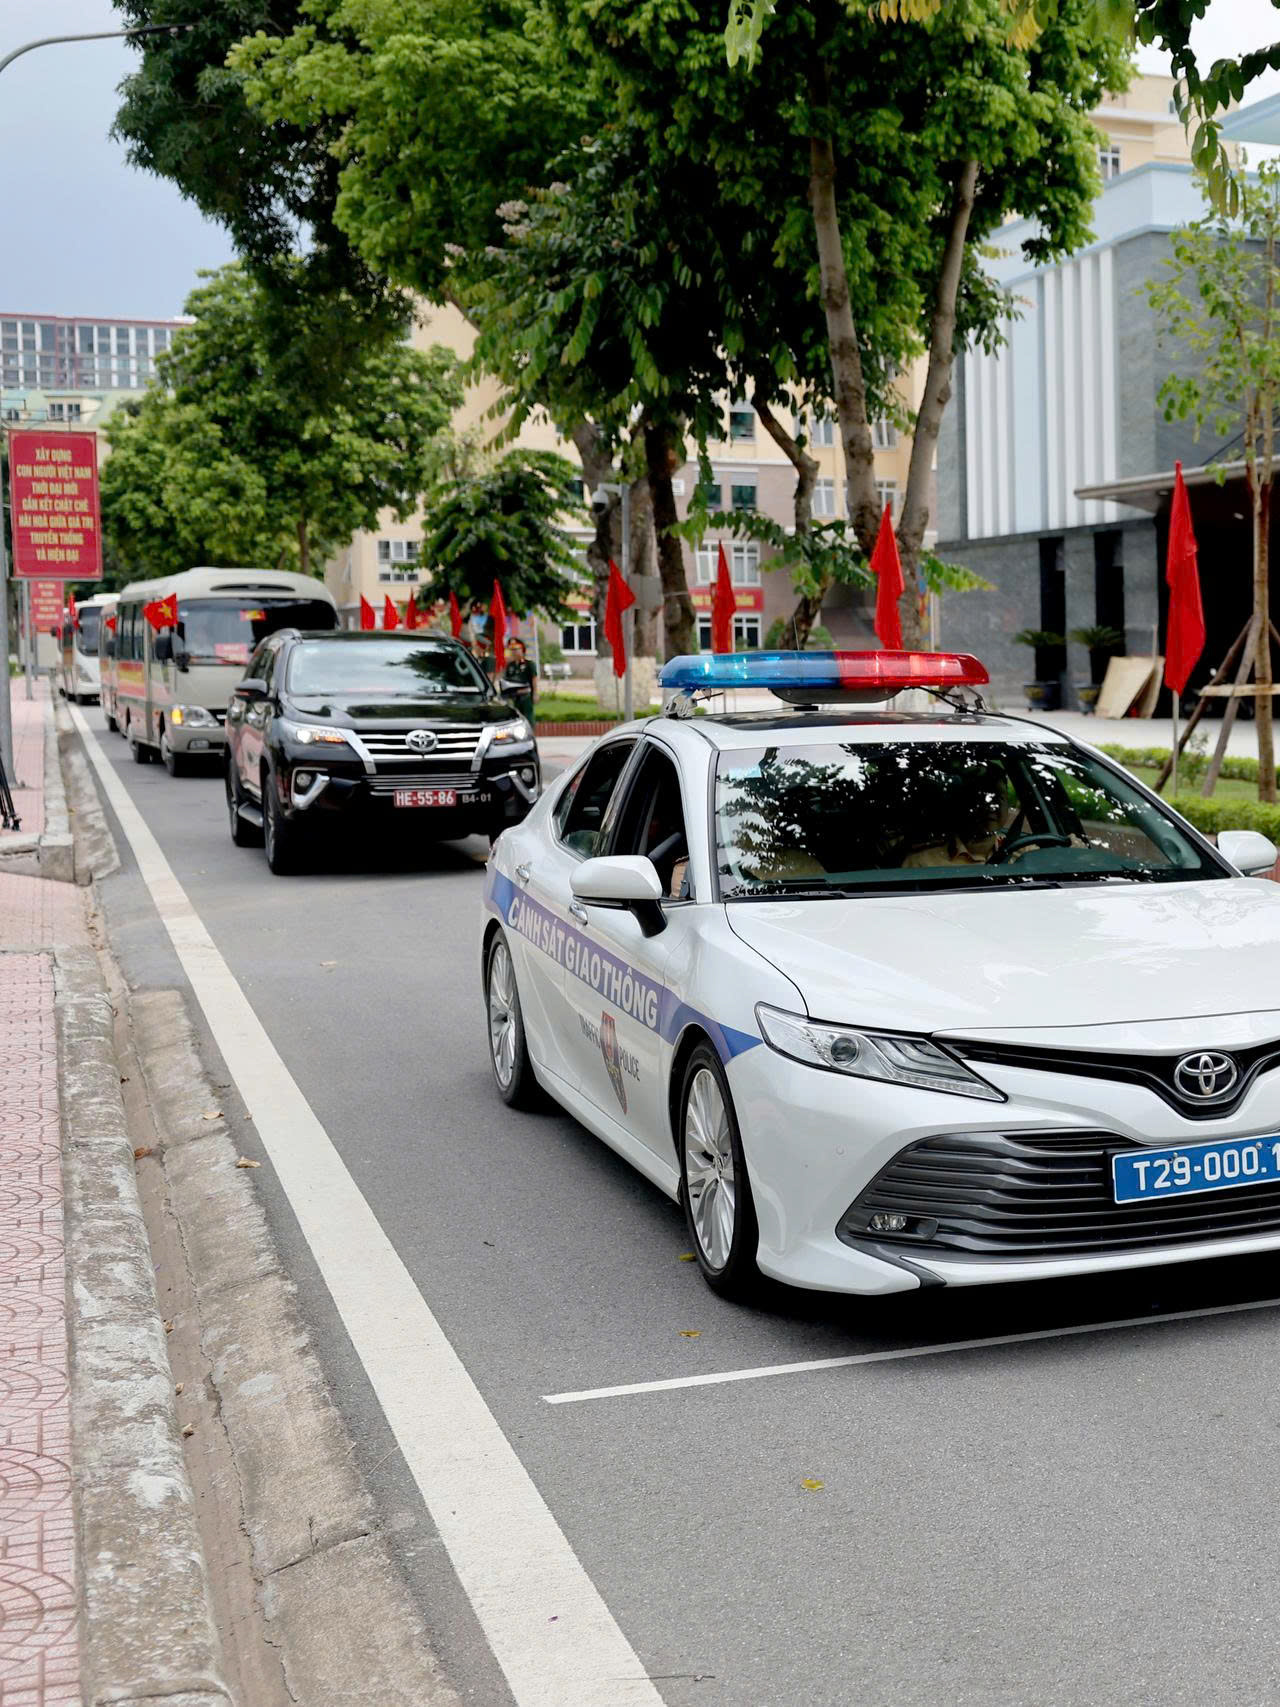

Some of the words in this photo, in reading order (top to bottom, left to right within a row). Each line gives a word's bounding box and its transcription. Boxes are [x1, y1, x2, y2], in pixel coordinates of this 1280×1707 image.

[396, 791, 454, 806] HE-55-86
[508, 896, 541, 947] CẢNH
[542, 918, 565, 961] SÁT
[565, 936, 601, 988] GIAO
[602, 966, 657, 1027] THÔNG
